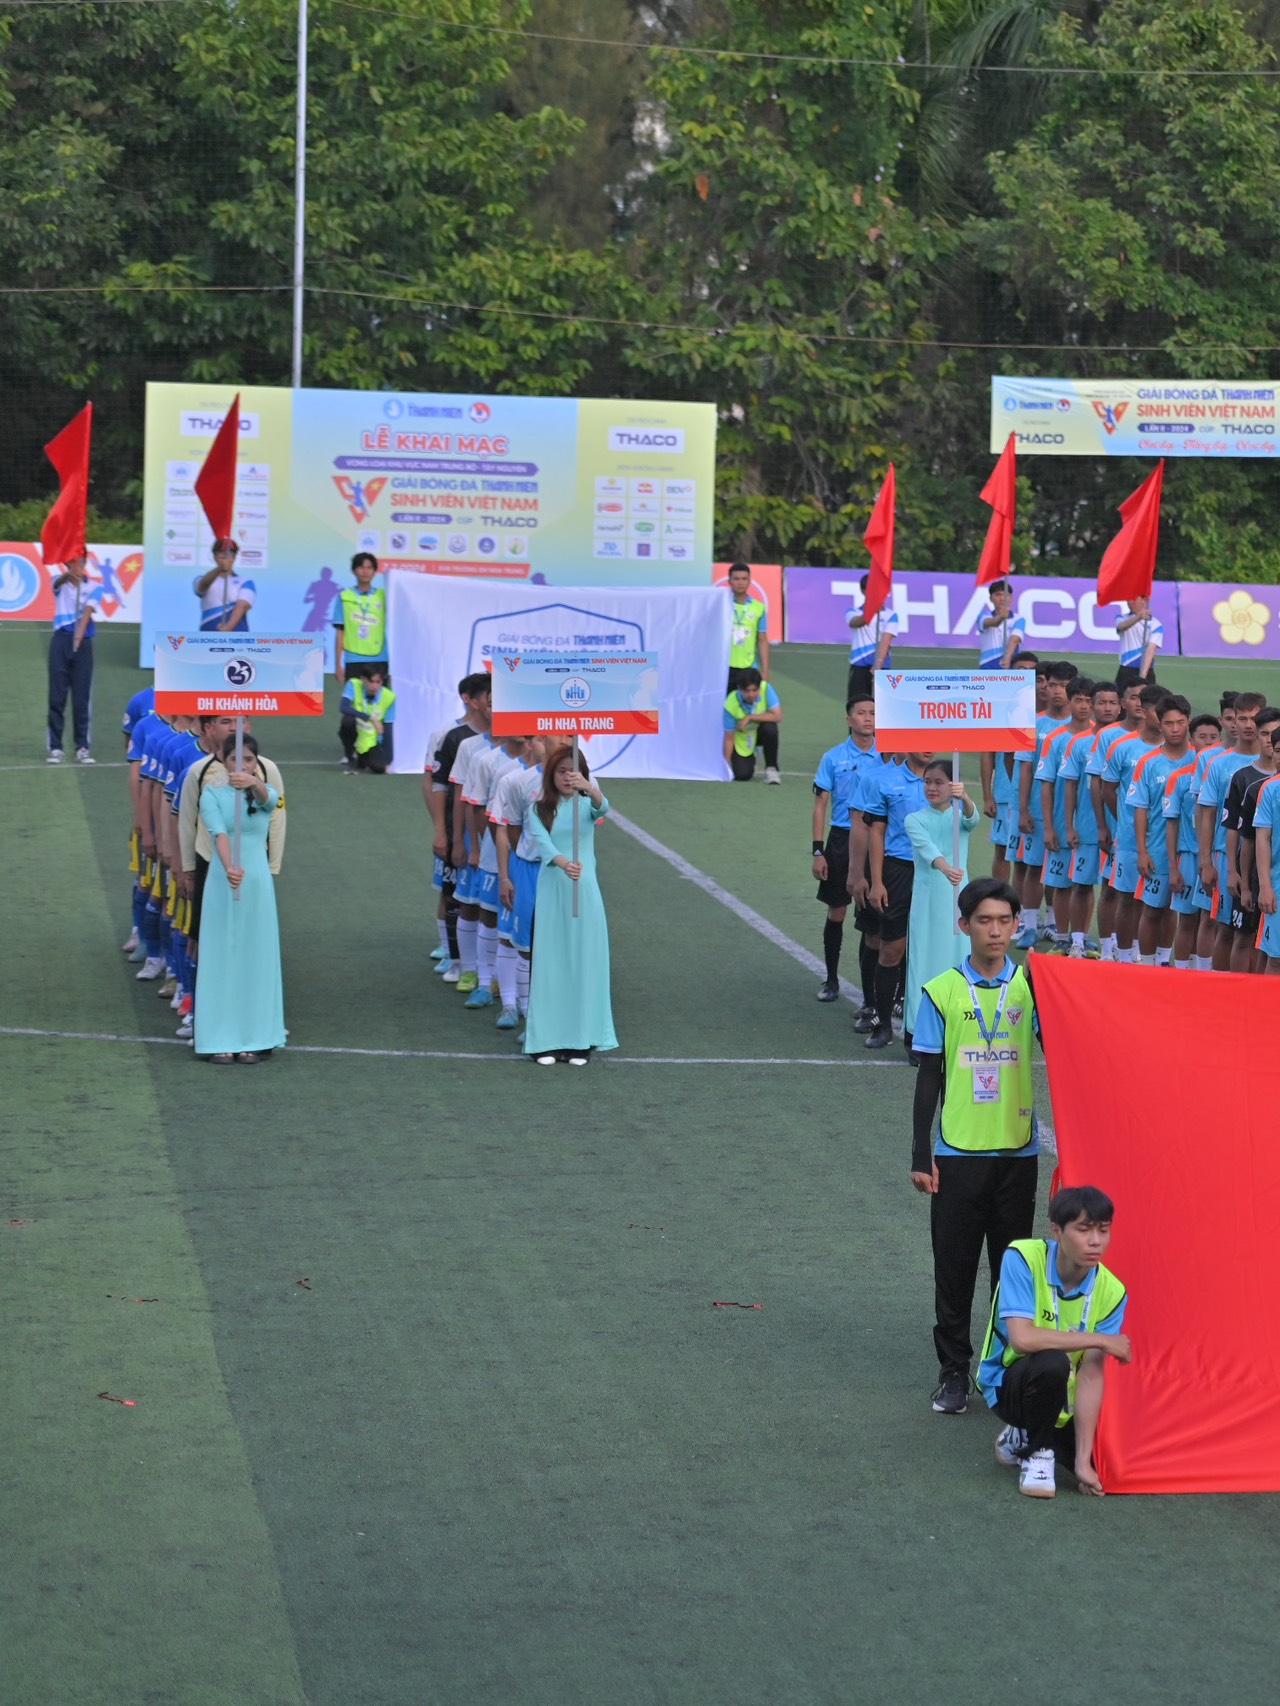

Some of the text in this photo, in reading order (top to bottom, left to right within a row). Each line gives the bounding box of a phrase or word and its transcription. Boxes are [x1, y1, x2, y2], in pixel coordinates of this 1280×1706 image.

[1137, 388, 1161, 400] GIẢI
[1164, 388, 1200, 401] BÓNG
[1201, 388, 1219, 400] ĐÁ
[1137, 403, 1275, 420] SINH VIÊN VIỆT NAM
[188, 418, 251, 431] THAO
[1221, 424, 1275, 434] THACO
[362, 426, 508, 458] LỄ KHAI MẠC
[616, 433, 677, 447] THACO
[391, 493, 538, 512] SINH VIÊN VIỆT NAM
[480, 516, 538, 528] THACO
[197, 694, 278, 711] ĐH KHÁNH HÒA
[918, 697, 992, 723] TRỌNG TÀI
[537, 717, 614, 730] ĐH NHA TRANG
[997, 820, 1002, 832] 7
[1025, 837, 1033, 850] 3
[1050, 860, 1064, 876] 22
[1076, 857, 1085, 871] 2
[1117, 865, 1122, 878] 5
[444, 866, 456, 884] 24
[460, 869, 467, 885] 2
[482, 874, 496, 892] 17
[1145, 879, 1161, 895] 23
[1232, 909, 1243, 928] 24
[1265, 926, 1270, 942] 4
[965, 1051, 1018, 1062] THACO
